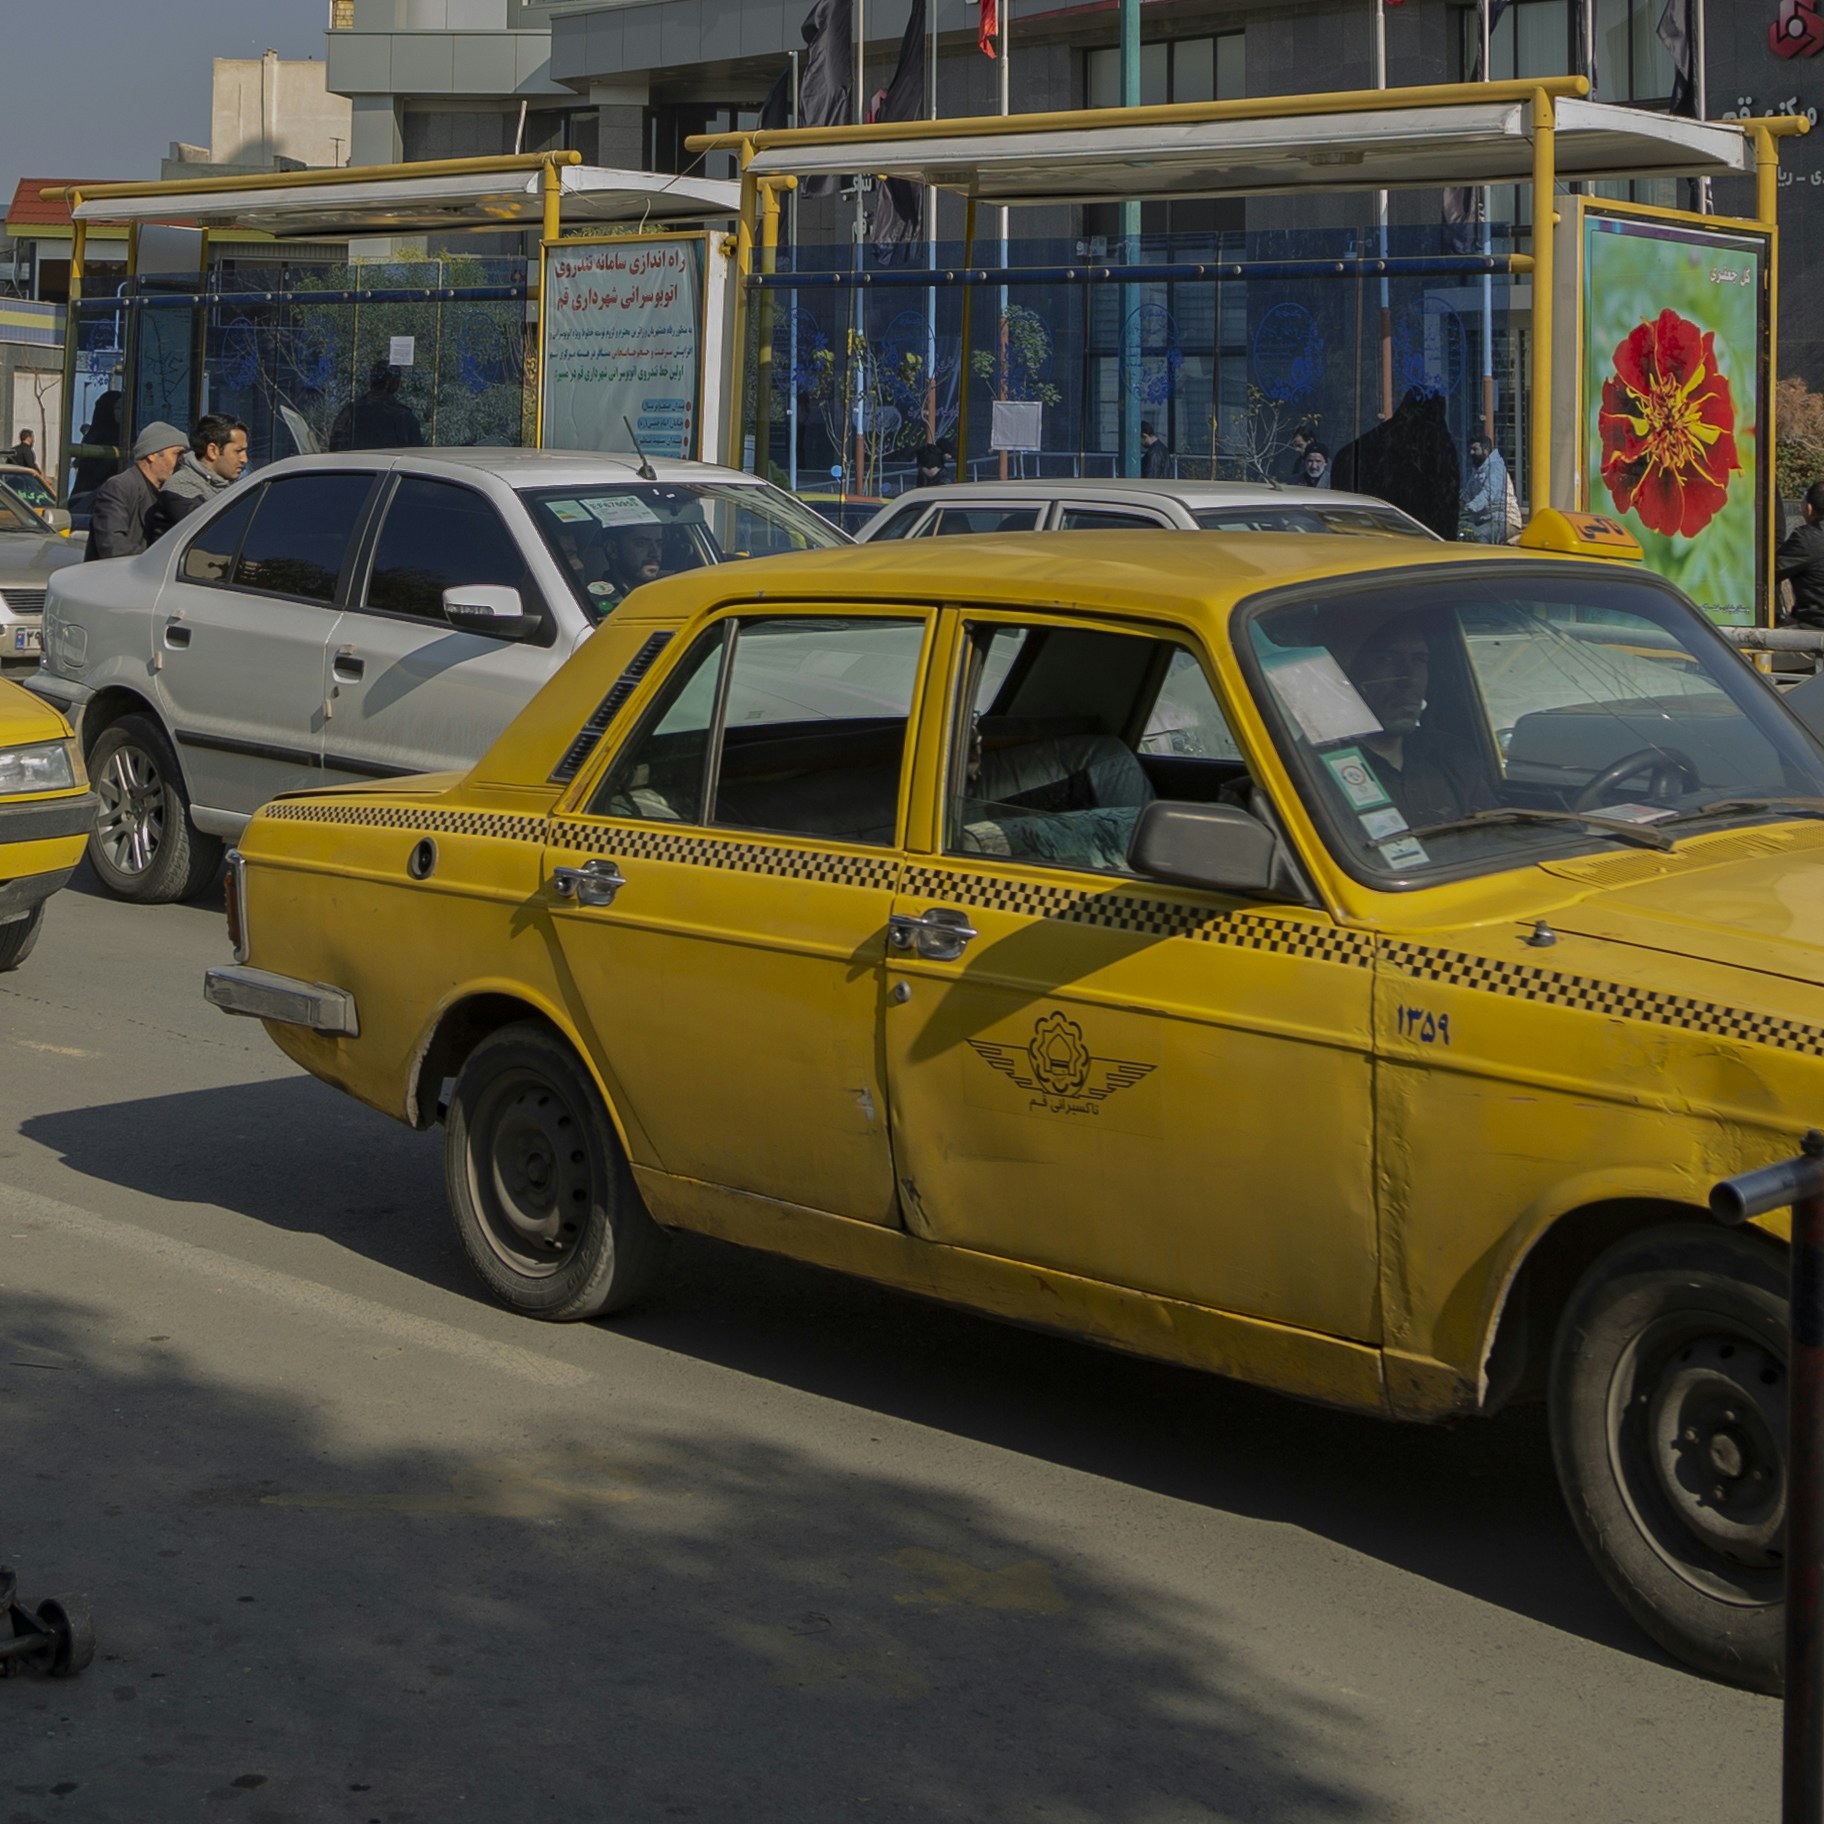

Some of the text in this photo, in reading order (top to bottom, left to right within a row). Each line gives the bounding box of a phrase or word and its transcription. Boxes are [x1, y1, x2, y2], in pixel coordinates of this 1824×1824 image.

[555, 250, 686, 279] راه اندازی سامانه تندروی
[1710, 266, 1737, 284] جعفری
[556, 283, 678, 312] اتوبوسرانی شهرداری قم
[1576, 517, 1625, 539] تاکسی
[1397, 1004, 1449, 1046] ۱۳۵۹
